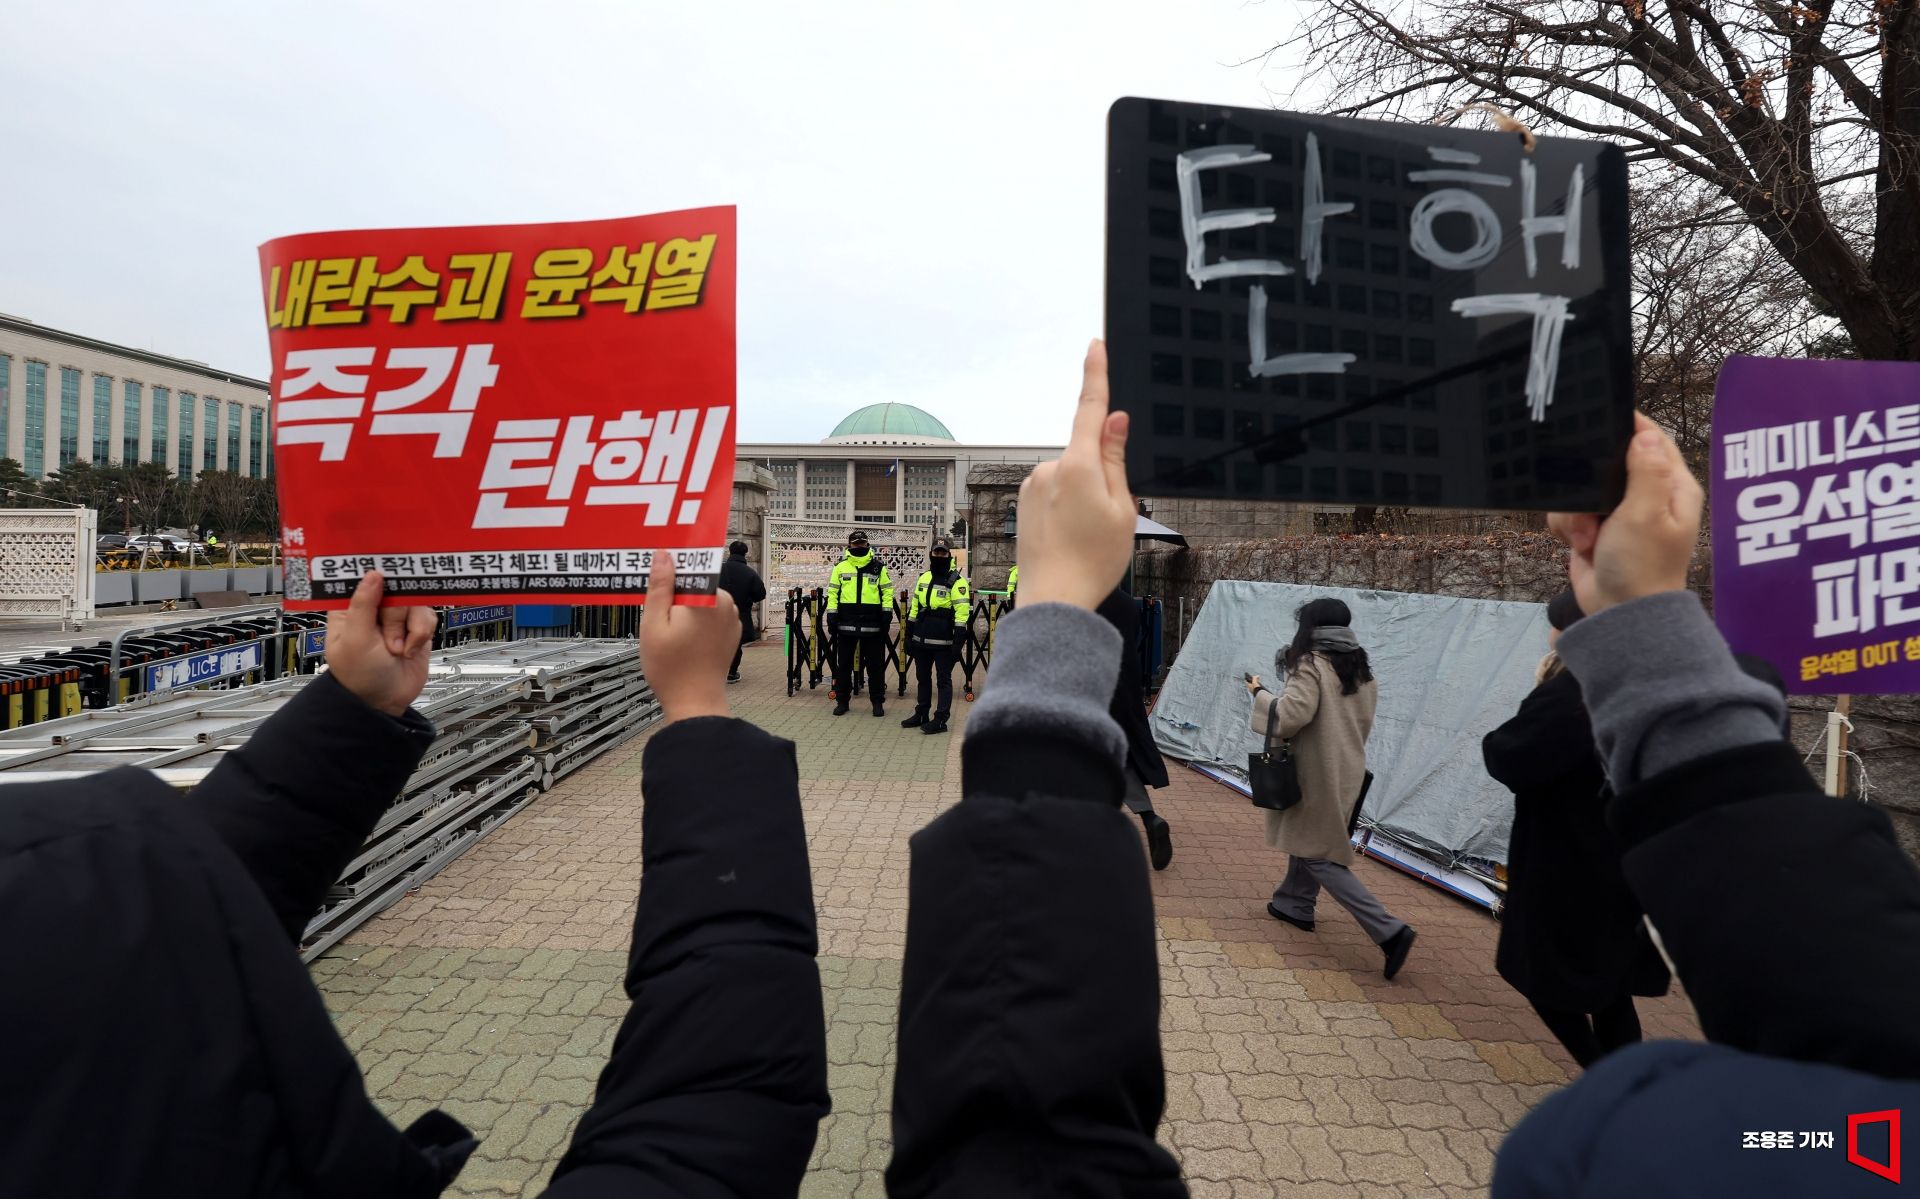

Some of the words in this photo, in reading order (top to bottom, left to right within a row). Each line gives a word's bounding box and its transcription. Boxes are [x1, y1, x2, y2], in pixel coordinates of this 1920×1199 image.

[269, 252, 512, 329] 내란수괴
[520, 233, 717, 318] 윤석열
[1177, 131, 1584, 422] 탄핵
[277, 343, 500, 462] 즉각
[1723, 403, 1920, 480] 페미니스트
[471, 405, 730, 529] 탄핵!
[1736, 459, 1920, 566] 윤석열
[321, 557, 376, 578] 윤석열
[381, 556, 415, 575] 즉각
[421, 555, 463, 574] 탄핵!
[470, 553, 504, 573] 즉각
[509, 552, 548, 572] 체포!
[554, 552, 568, 571] 될
[574, 551, 620, 571] 때까지
[625, 551, 658, 571] 국회
[676, 550, 713, 570] 모이자!
[528, 577, 547, 588] ARS
[462, 610, 488, 622] POLICE
[490, 607, 504, 617] LINE
[1800, 648, 1857, 681] 윤석열
[1862, 640, 1900, 668] OUT
